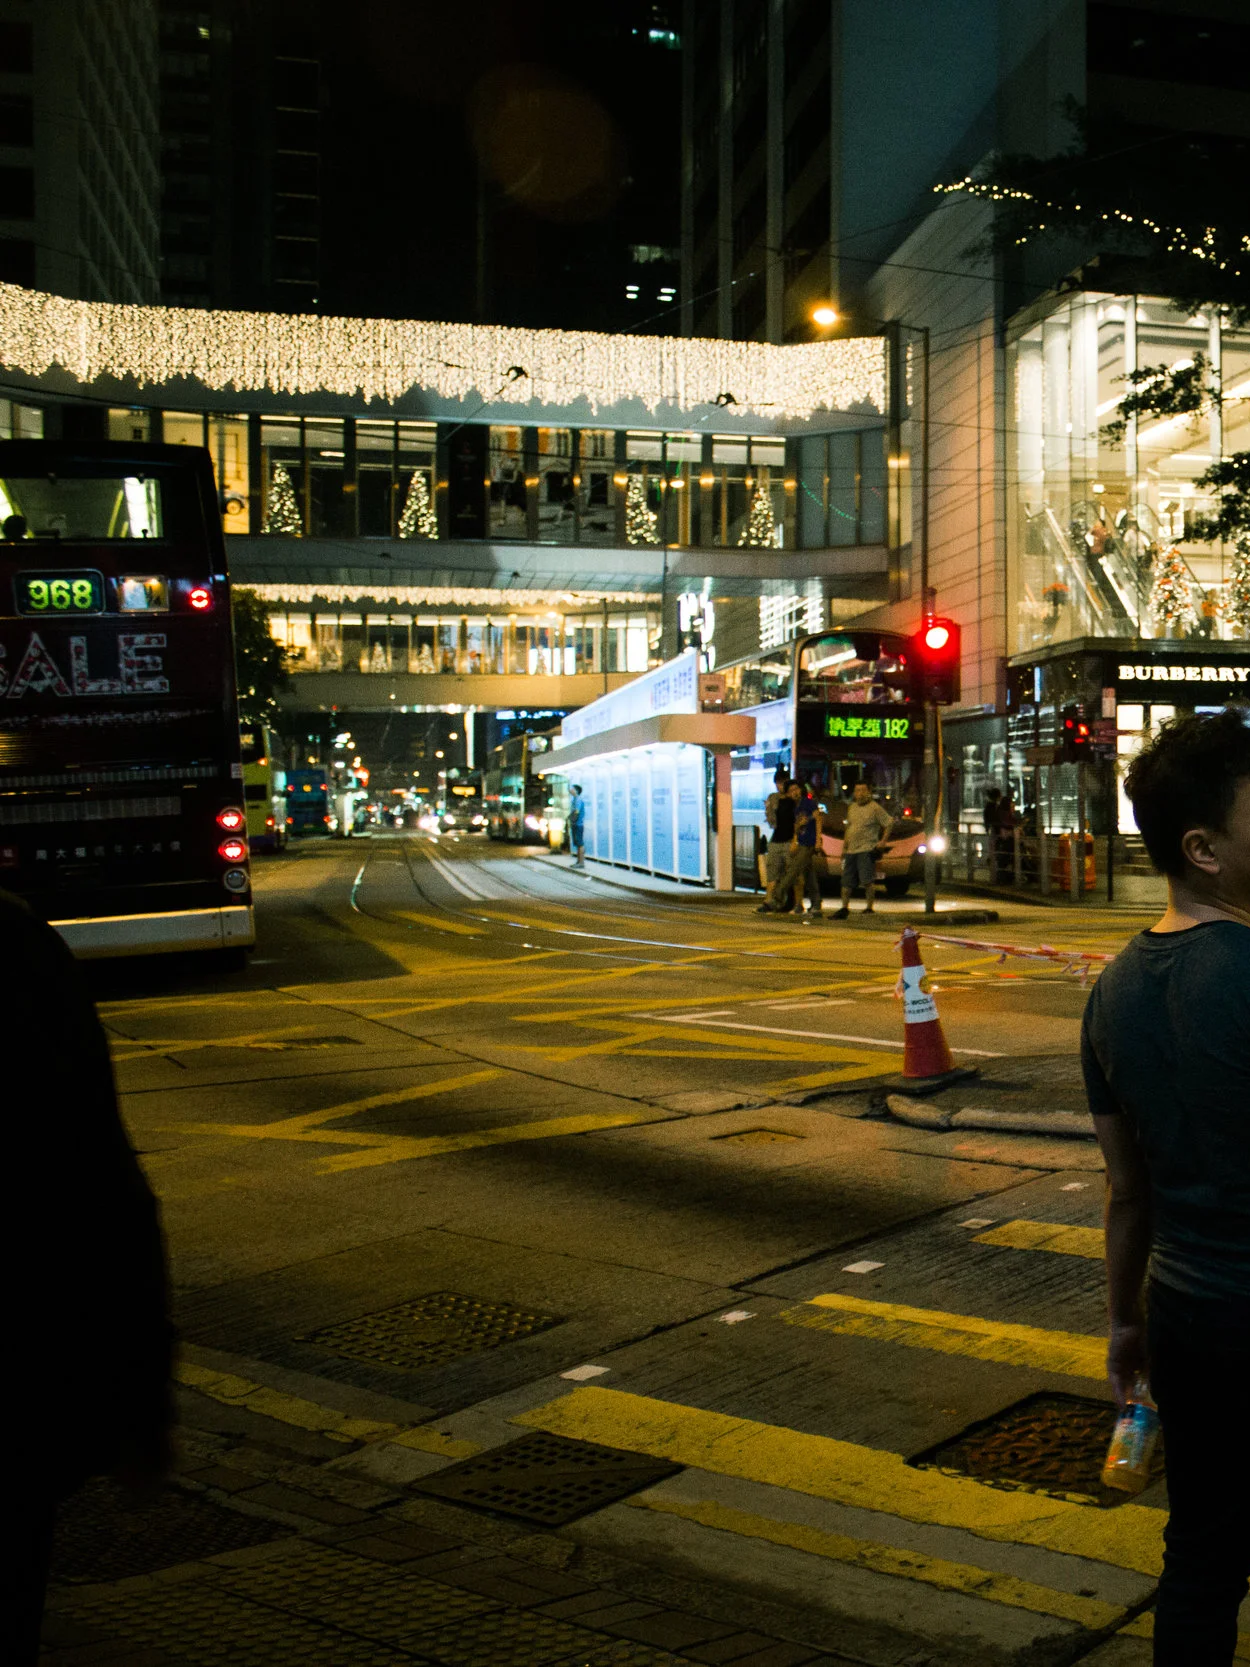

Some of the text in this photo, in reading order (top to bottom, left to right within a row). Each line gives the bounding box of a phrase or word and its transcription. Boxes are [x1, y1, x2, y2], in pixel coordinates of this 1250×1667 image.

[28, 579, 92, 610] 968
[0, 631, 170, 700] ALE
[1118, 665, 1250, 682] BURBERRY
[884, 718, 909, 738] 182
